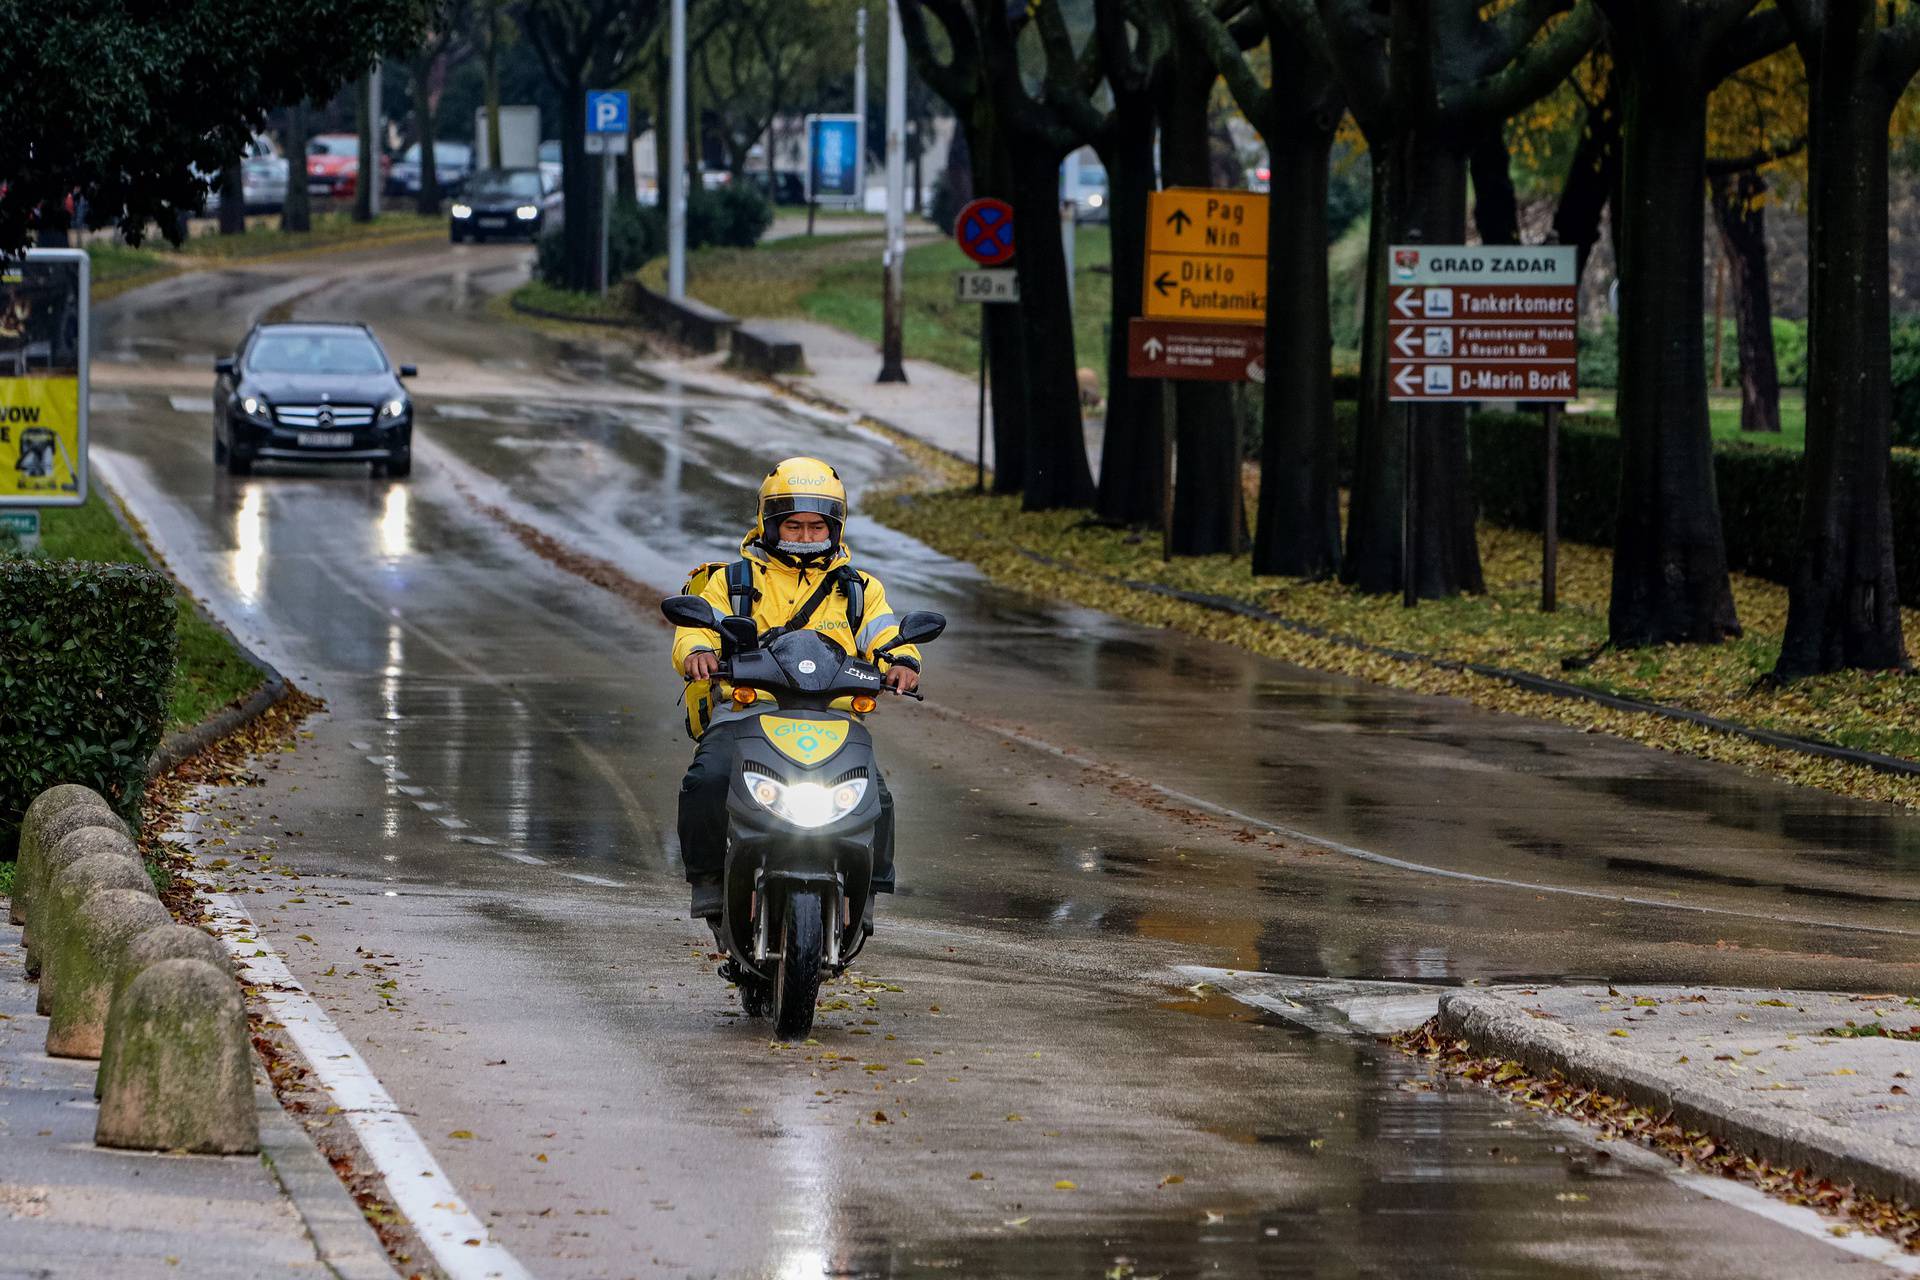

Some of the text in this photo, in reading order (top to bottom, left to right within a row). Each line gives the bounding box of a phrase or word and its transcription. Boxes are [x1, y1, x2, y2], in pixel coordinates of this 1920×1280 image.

[597, 104, 618, 131] P
[1206, 199, 1244, 225] Pag
[1205, 227, 1240, 246] Nin
[1181, 260, 1235, 283] Diklo
[1430, 258, 1557, 272] GRAD ZADAR
[971, 276, 992, 296] 50
[1460, 293, 1574, 313] Tankerkomerc
[1459, 327, 1575, 341] Falkensteiner Hotels
[1471, 343, 1516, 356] Resorts
[1518, 343, 1548, 356] Borik
[1459, 370, 1572, 390] D-Marin Borik
[787, 475, 822, 486] Glovo
[815, 621, 848, 631] Glovo
